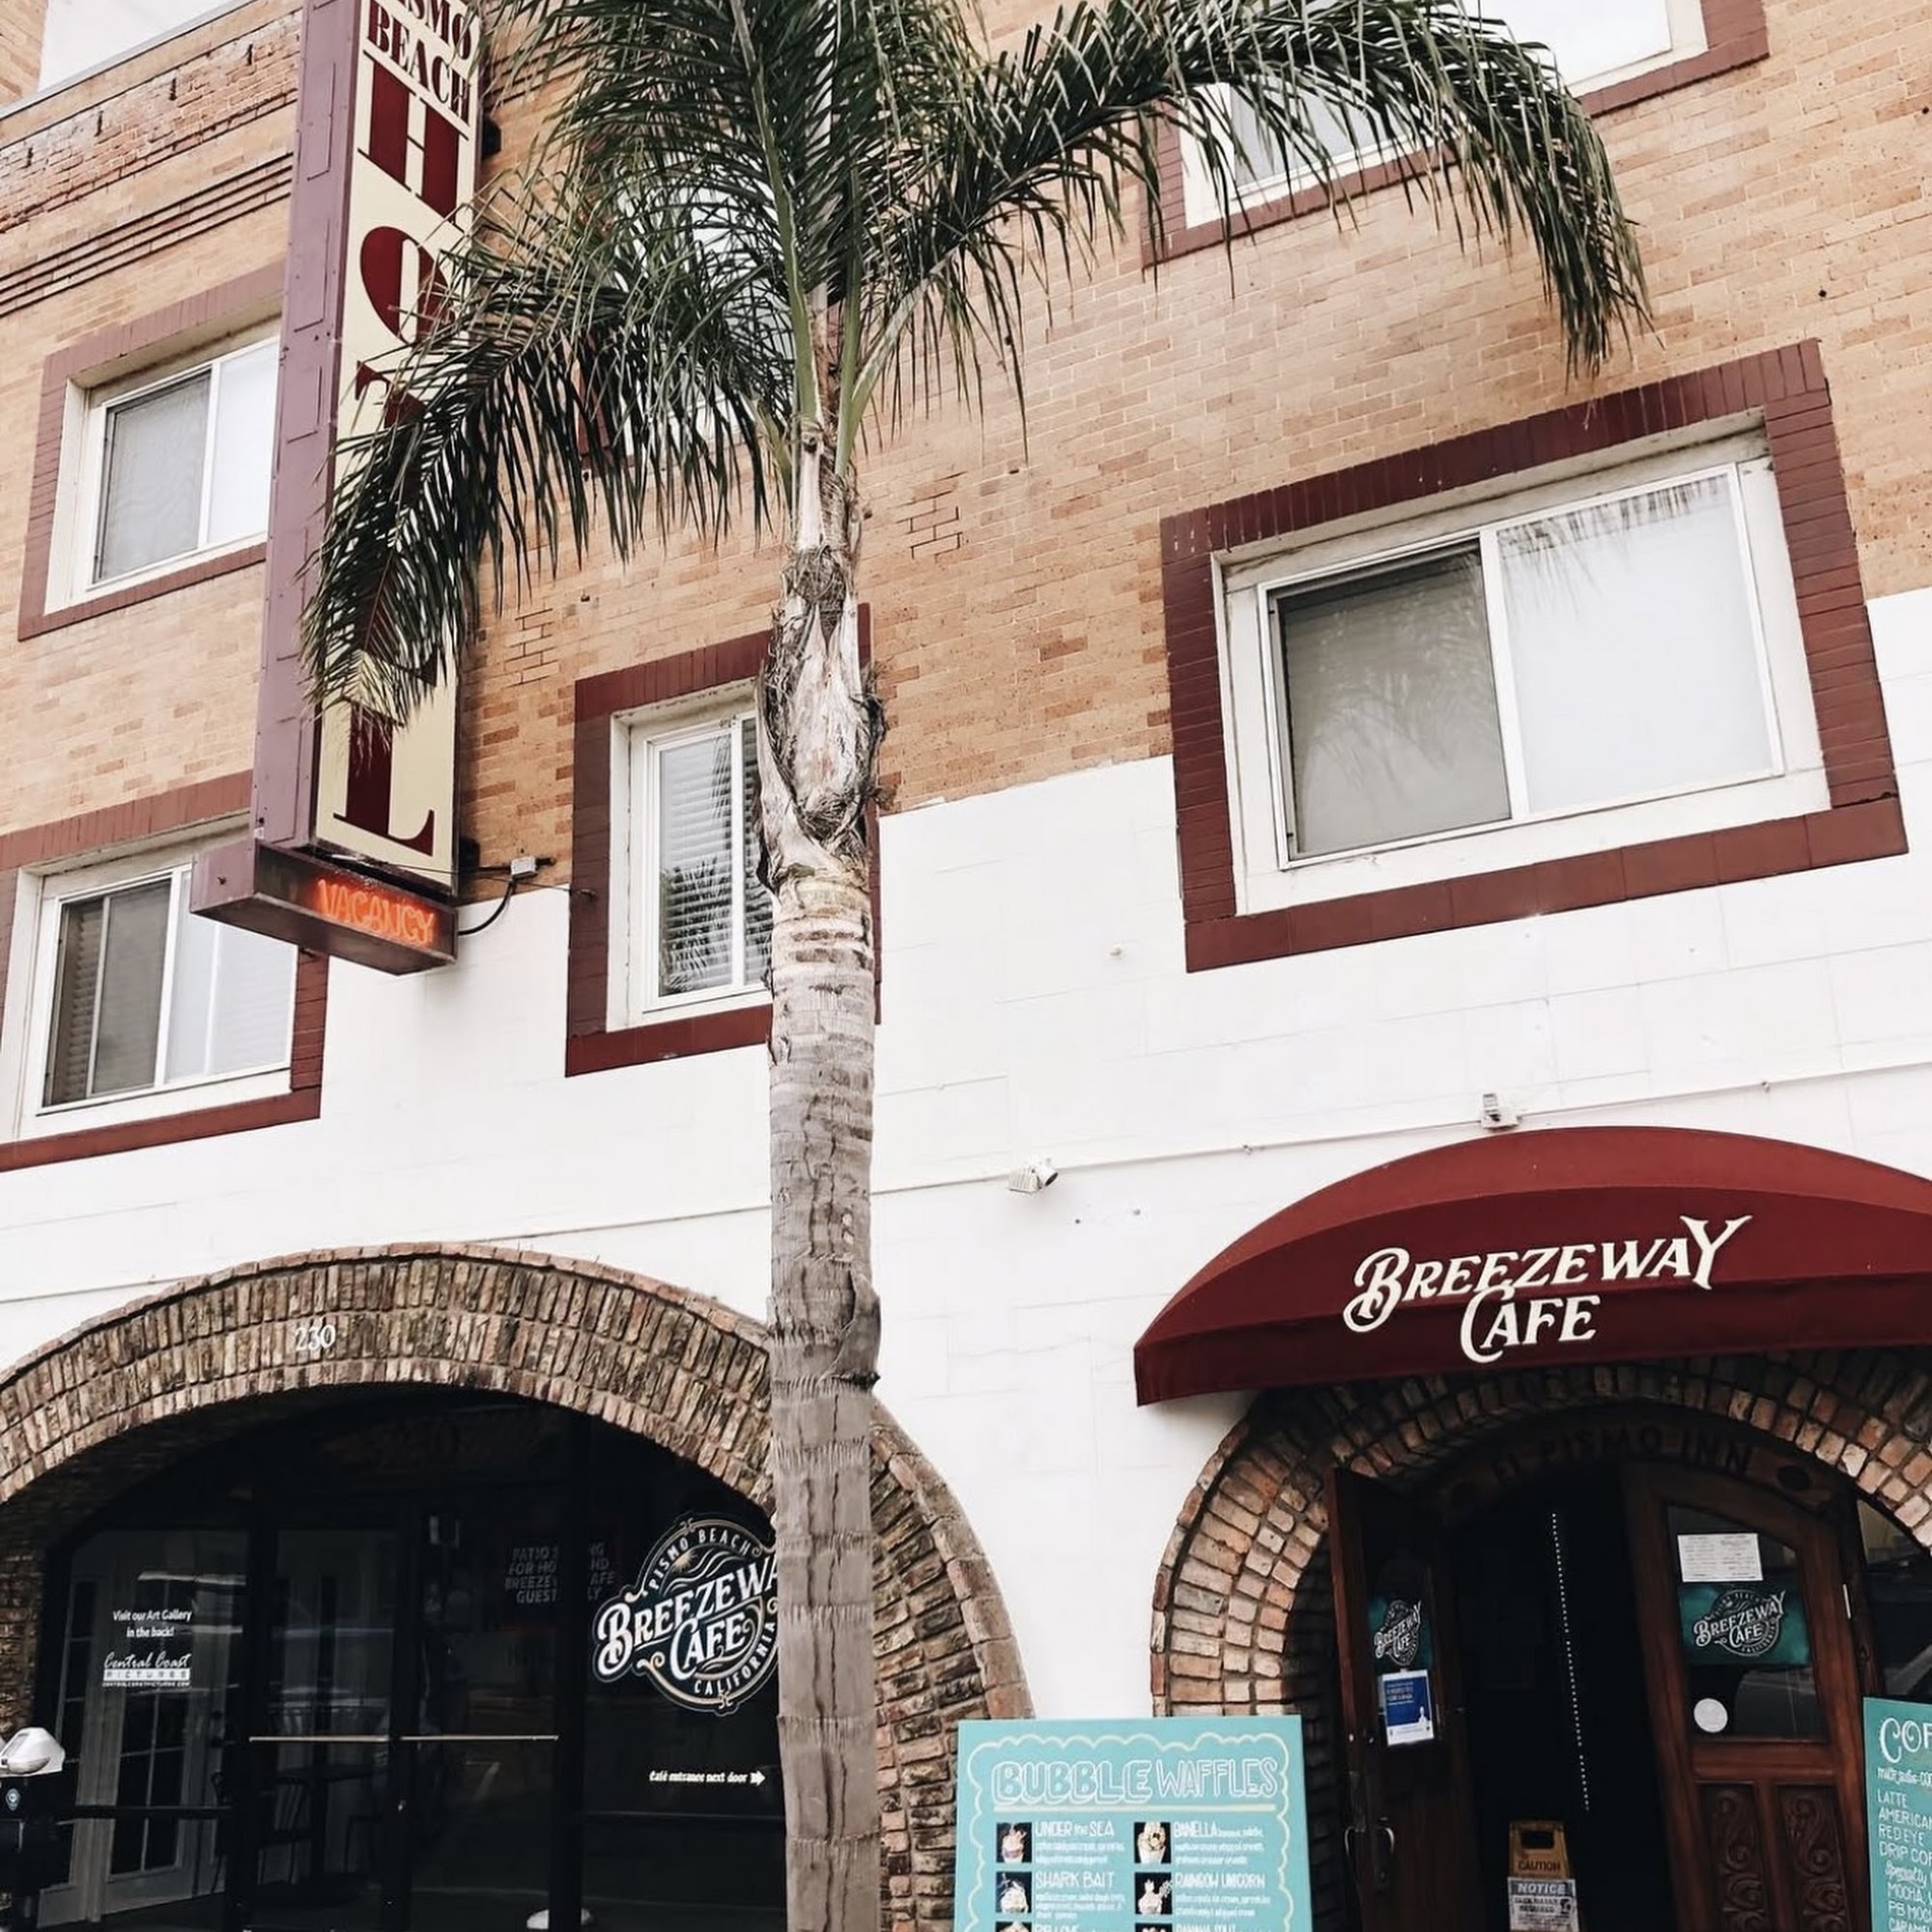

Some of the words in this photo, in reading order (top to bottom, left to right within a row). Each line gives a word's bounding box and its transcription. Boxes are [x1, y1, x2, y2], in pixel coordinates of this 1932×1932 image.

[366, 0, 471, 127] BEACH
[317, 879, 435, 945] VACANCY
[1343, 1215, 1753, 1332] BREEZEWAY
[1460, 1283, 1601, 1363] CAFE
[295, 1324, 336, 1350] 230
[1540, 1425, 1662, 1464] PISMO
[1681, 1431, 1752, 1478] INN
[648, 1537, 689, 1589] PISMO
[698, 1527, 752, 1556] BEACH
[113, 1609, 131, 1621] Visit
[131, 1612, 146, 1621] our
[146, 1610, 160, 1621] Art
[161, 1609, 192, 1622] Gallery
[597, 1557, 778, 1676] BREEZEWA
[1693, 1590, 1786, 1647] BREEZEWAY
[136, 1626, 150, 1637] the
[1374, 1600, 1422, 1659] BREEZEWAY
[1729, 1622, 1763, 1648] CAFE
[669, 1612, 746, 1680] CAFE
[694, 1622, 776, 1695] CALIFORNIA
[103, 1651, 154, 1669] Central
[155, 1650, 192, 1669] Coast
[105, 1670, 187, 1679] PICTURES
[668, 1772, 705, 1782] entrance
[706, 1772, 725, 1783] next
[726, 1771, 749, 1783] door
[991, 1760, 1152, 1805] BUBBLE
[1155, 1756, 1279, 1800] WAFFLES
[1877, 1788, 1908, 1809] LATTE
[1035, 1821, 1072, 1836] UNDER
[1090, 1821, 1115, 1836] SEA
[1879, 1823, 1901, 1840] RED
[1904, 1828, 1924, 1847] EYE
[1879, 1841, 1909, 1861] DRIP
[1518, 1861, 1561, 1872] CAUTION
[1035, 1871, 1080, 1889] SHARK
[1083, 1871, 1116, 1889] BAIT
[1175, 1872, 1218, 1889] RAINBOW
[1220, 1871, 1265, 1889] UNICORN
[1518, 1883, 1566, 1894] NOTICE
